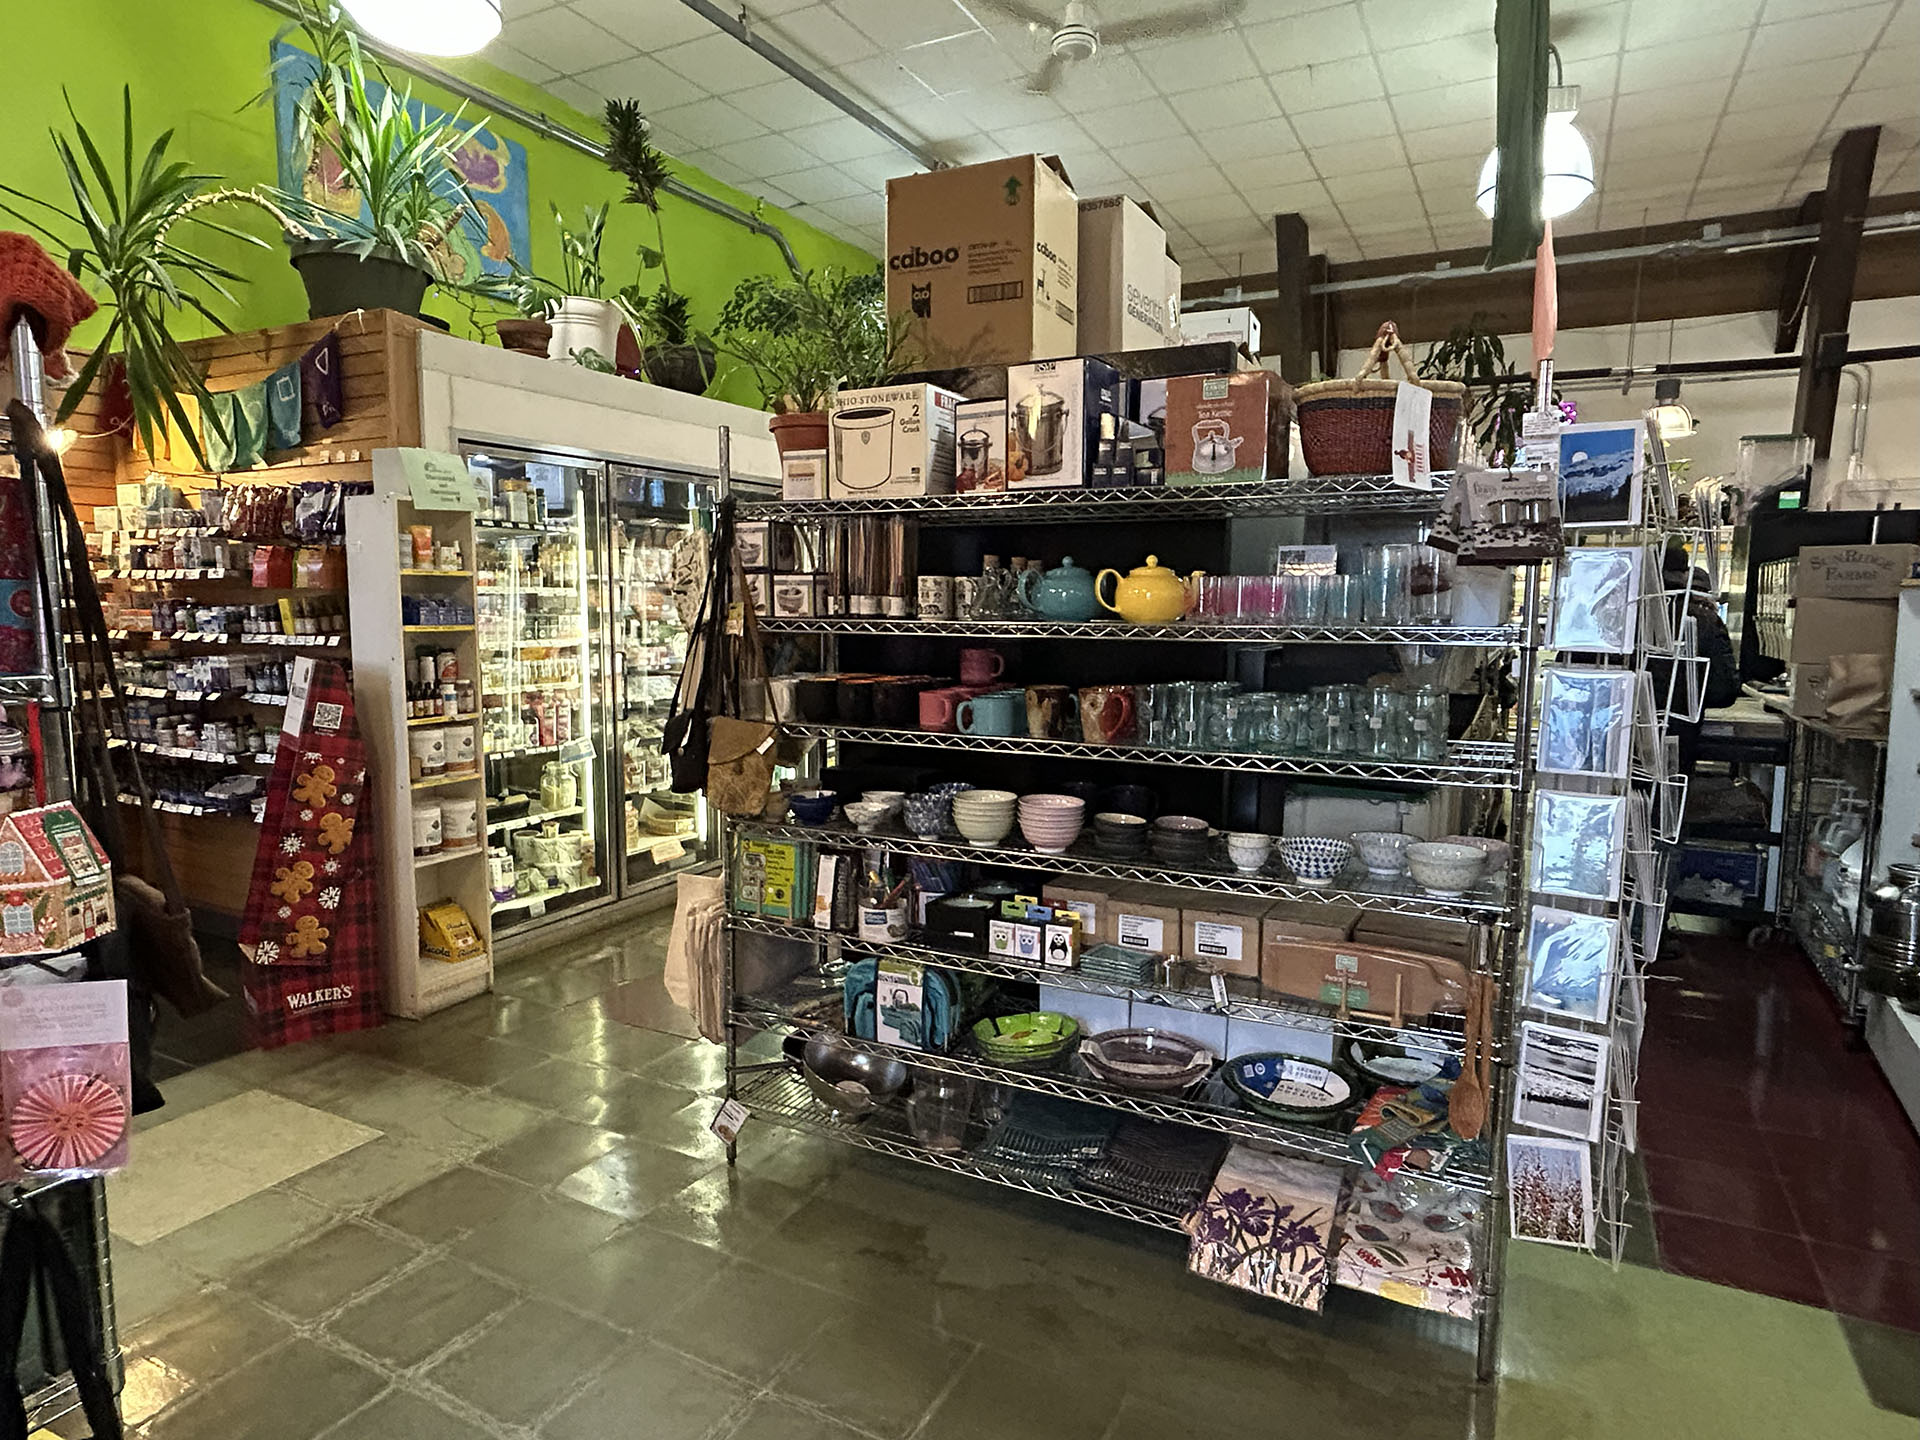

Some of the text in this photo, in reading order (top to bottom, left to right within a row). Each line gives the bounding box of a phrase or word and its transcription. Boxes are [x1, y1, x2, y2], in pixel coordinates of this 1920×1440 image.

[889, 246, 959, 271] caboo
[859, 388, 919, 405] STONEWARE
[912, 404, 920, 417] 2
[900, 417, 920, 426] Gallon
[902, 425, 920, 434] Crock
[286, 984, 352, 1009] WALKER'S
